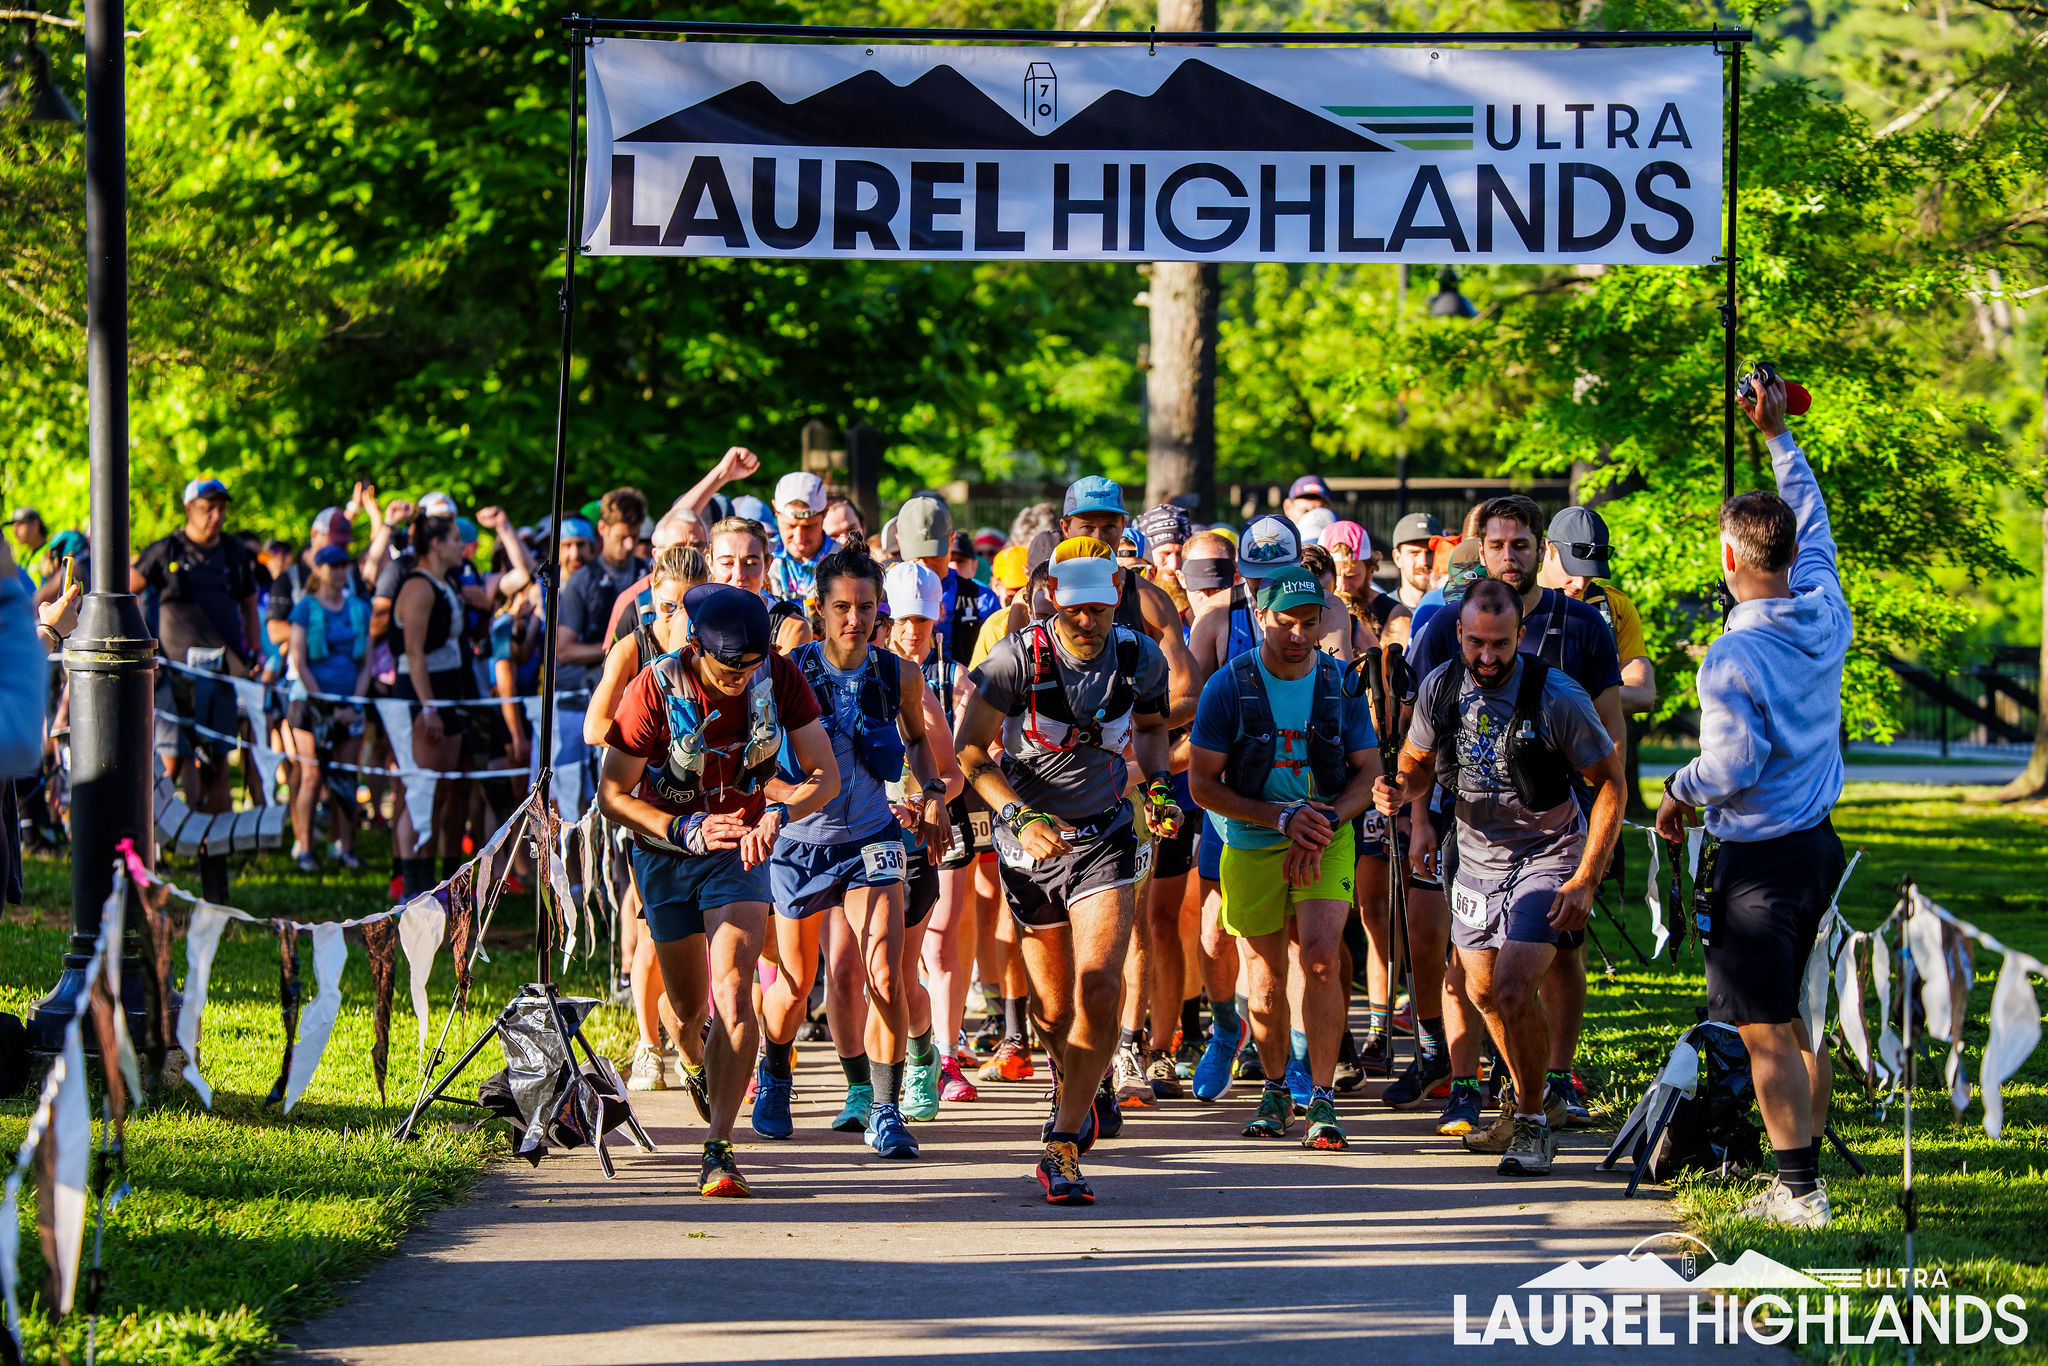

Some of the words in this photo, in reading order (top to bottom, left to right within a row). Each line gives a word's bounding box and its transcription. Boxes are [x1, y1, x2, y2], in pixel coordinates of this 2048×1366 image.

[1486, 102, 1693, 150] ULTRA
[609, 154, 1026, 252] LAUREL
[1052, 160, 1695, 254] HIGHLANDS
[1282, 580, 1316, 593] HYNER
[874, 850, 904, 870] 536
[1456, 892, 1478, 918] 667
